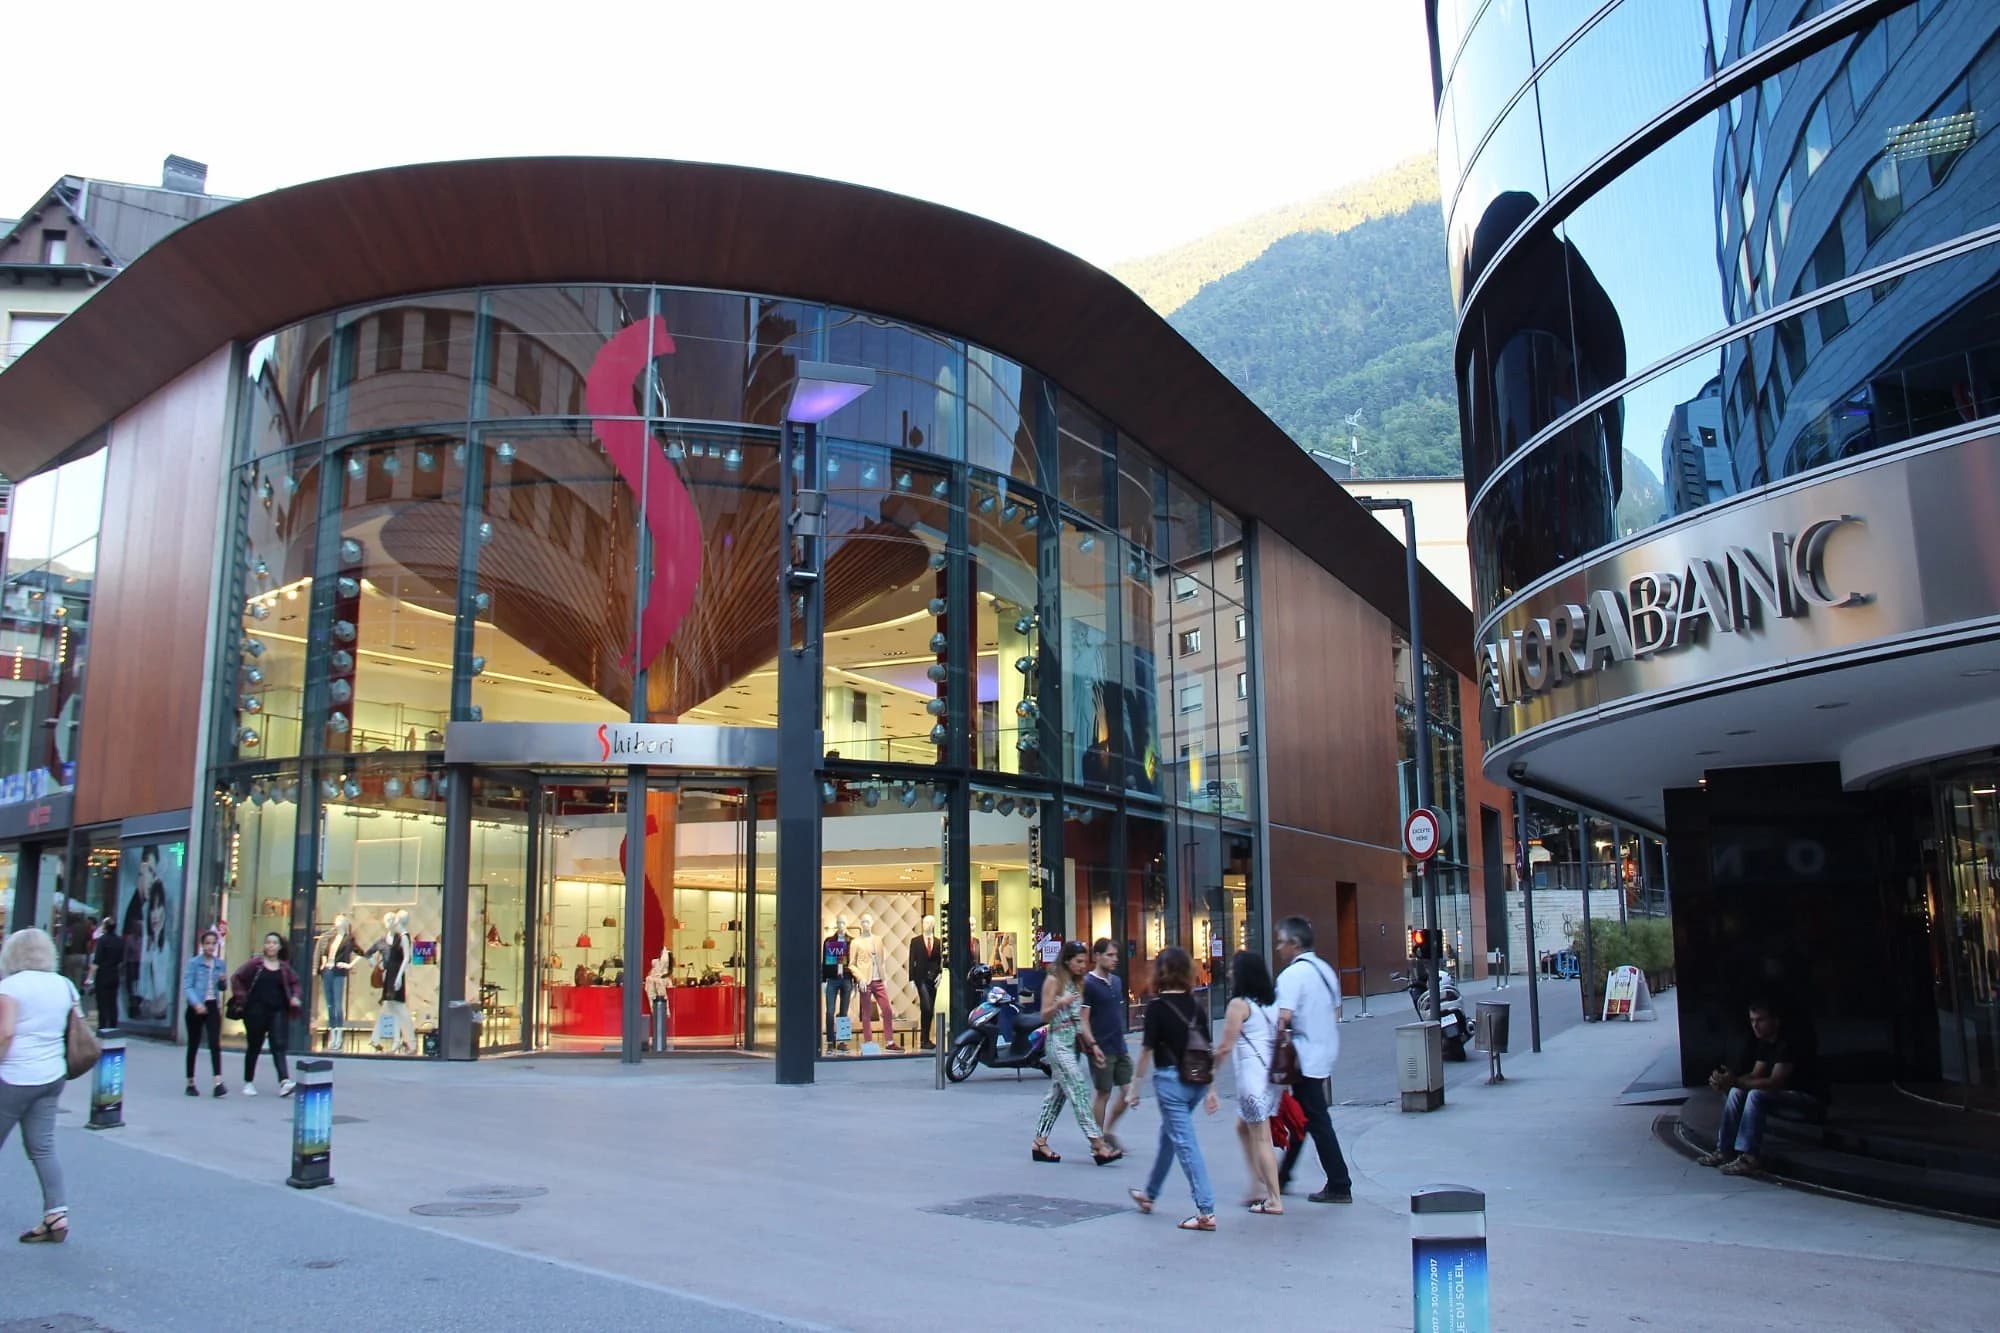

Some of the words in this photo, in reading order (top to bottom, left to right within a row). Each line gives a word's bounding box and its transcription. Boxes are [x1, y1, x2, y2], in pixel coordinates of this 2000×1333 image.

[1495, 514, 1867, 707] MORABANC
[597, 723, 674, 762] Shibori
[828, 947, 844, 956] VM
[1454, 1257, 1465, 1301] SOLEIL.
[1455, 1302, 1465, 1319] DU
